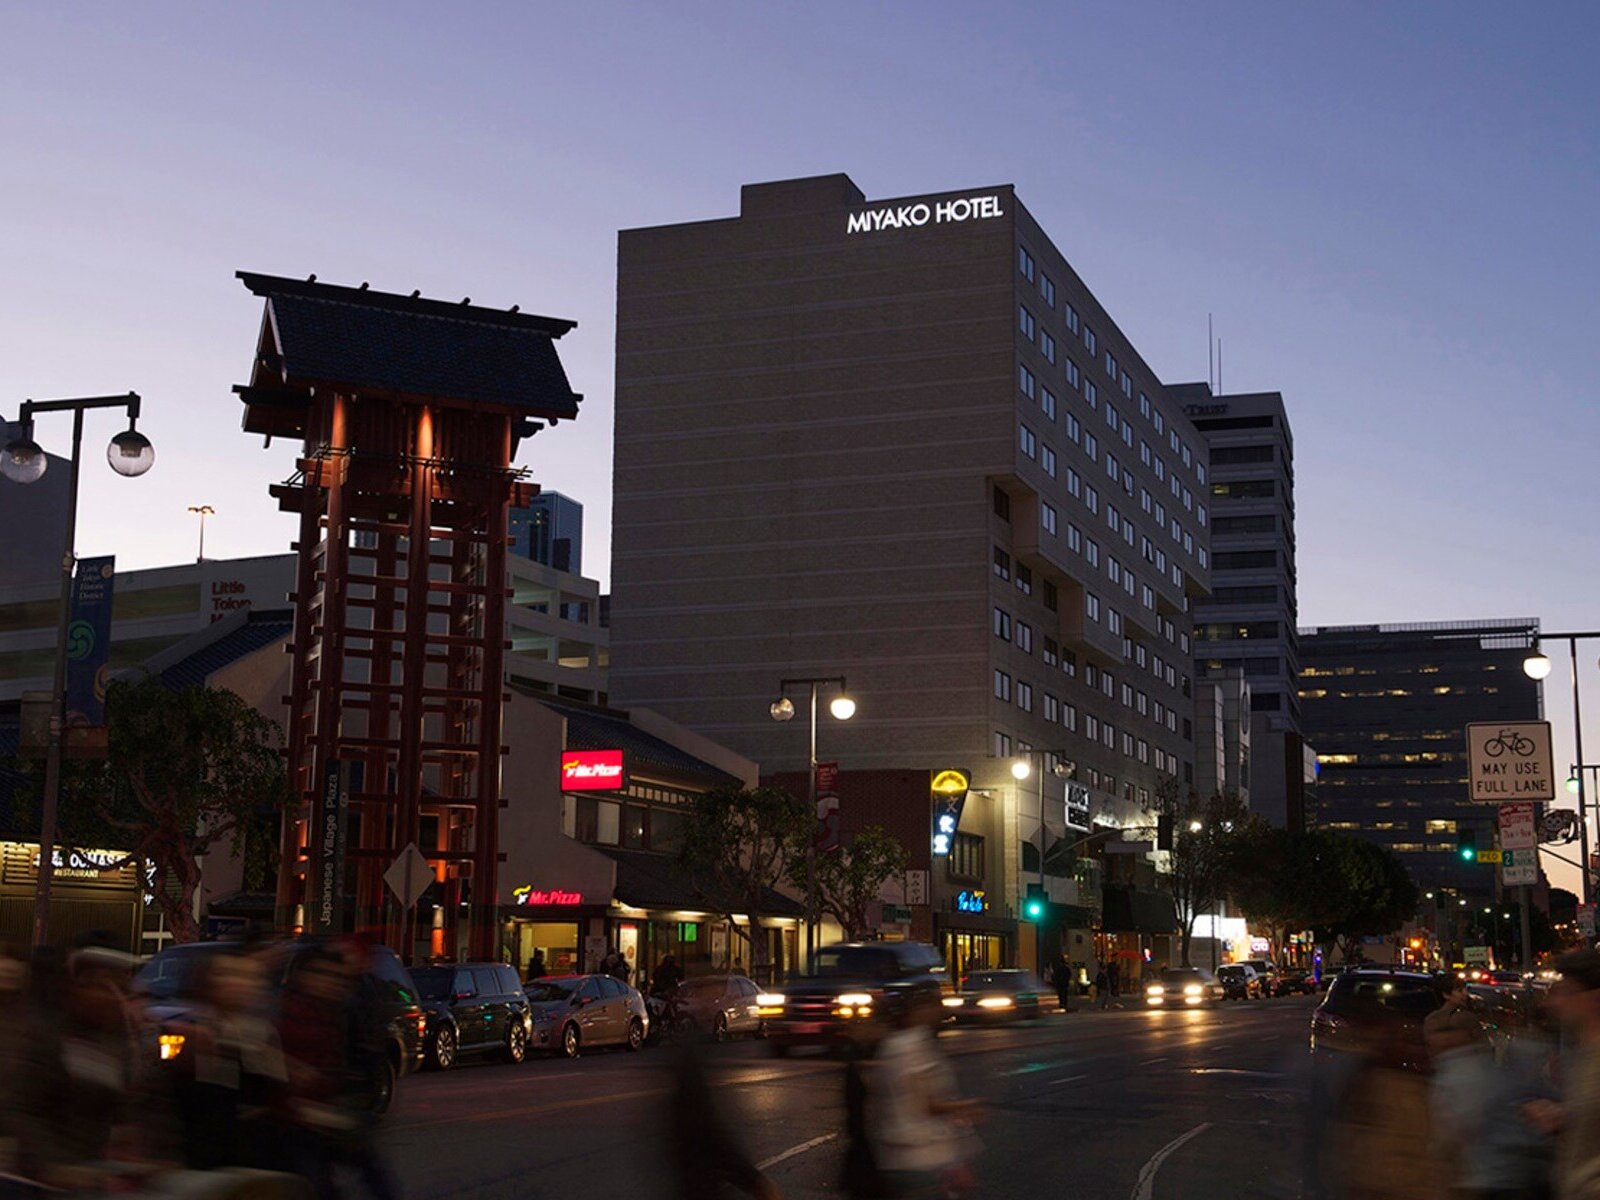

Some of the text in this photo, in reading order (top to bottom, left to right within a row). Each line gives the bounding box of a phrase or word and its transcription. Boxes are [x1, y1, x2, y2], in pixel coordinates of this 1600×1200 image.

[847, 195, 1004, 234] MIYAKO HOTEL
[212, 581, 245, 595] Little
[1482, 762, 1540, 775] MAY USE
[1477, 779, 1547, 793] FULL LANE
[319, 773, 338, 927] Japanese Village Plaza
[54, 868, 99, 879] RESTAURANT
